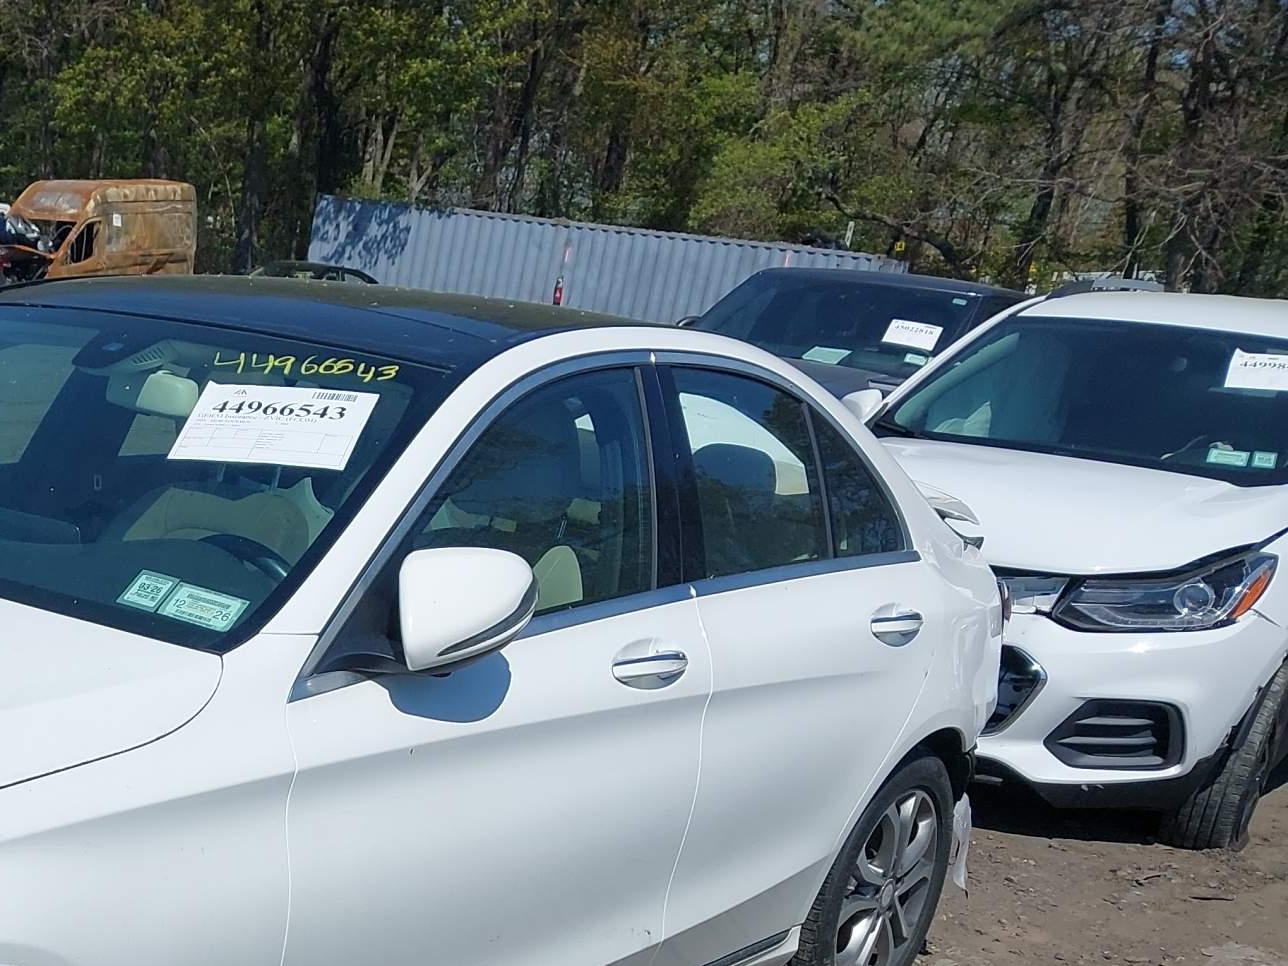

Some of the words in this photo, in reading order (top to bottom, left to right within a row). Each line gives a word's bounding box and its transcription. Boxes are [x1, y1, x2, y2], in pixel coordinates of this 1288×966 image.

[214, 351, 399, 382] 44966543
[1239, 361, 1288, 369] 44998
[212, 400, 347, 421] 44966543
[172, 598, 187, 609] 12
[212, 610, 231, 622] 26
